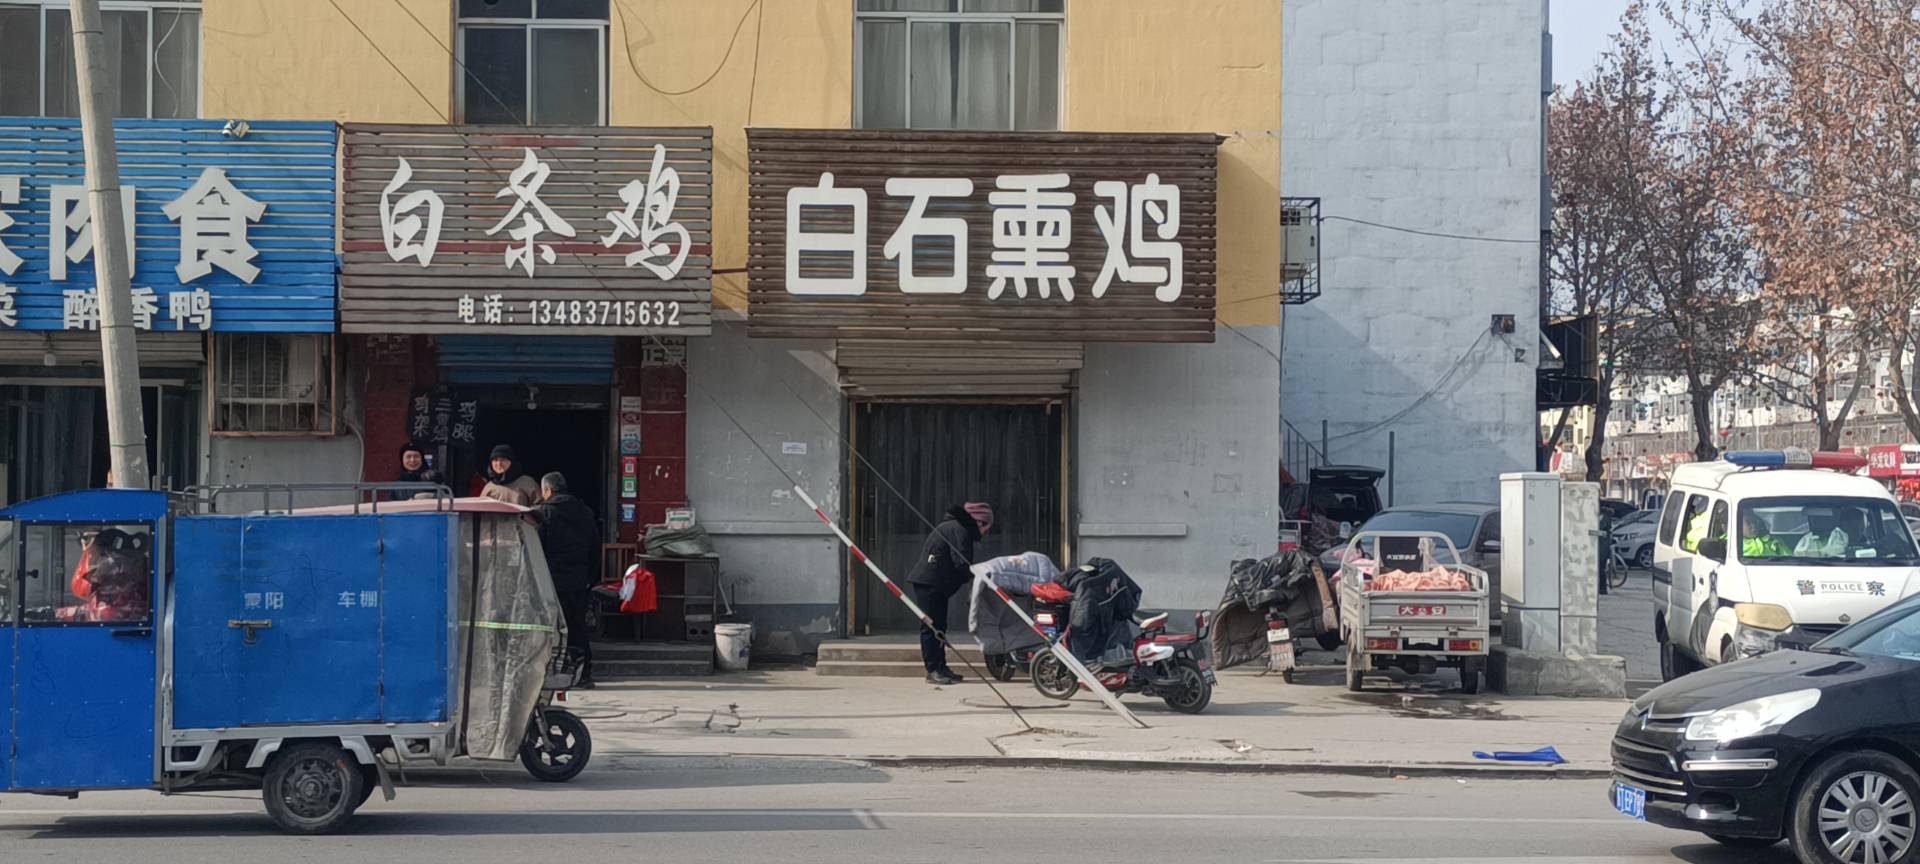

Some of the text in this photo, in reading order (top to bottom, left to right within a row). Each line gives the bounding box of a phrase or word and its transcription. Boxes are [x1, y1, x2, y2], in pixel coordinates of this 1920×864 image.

[0, 167, 268, 284] 肉食
[379, 144, 692, 281] 白条鸡
[786, 172, 1183, 302] 白石熏鸡
[529, 301, 682, 327] 13483715632
[337, 590, 378, 608] 车棚
[1797, 580, 1886, 596] 警 POLICE 察
